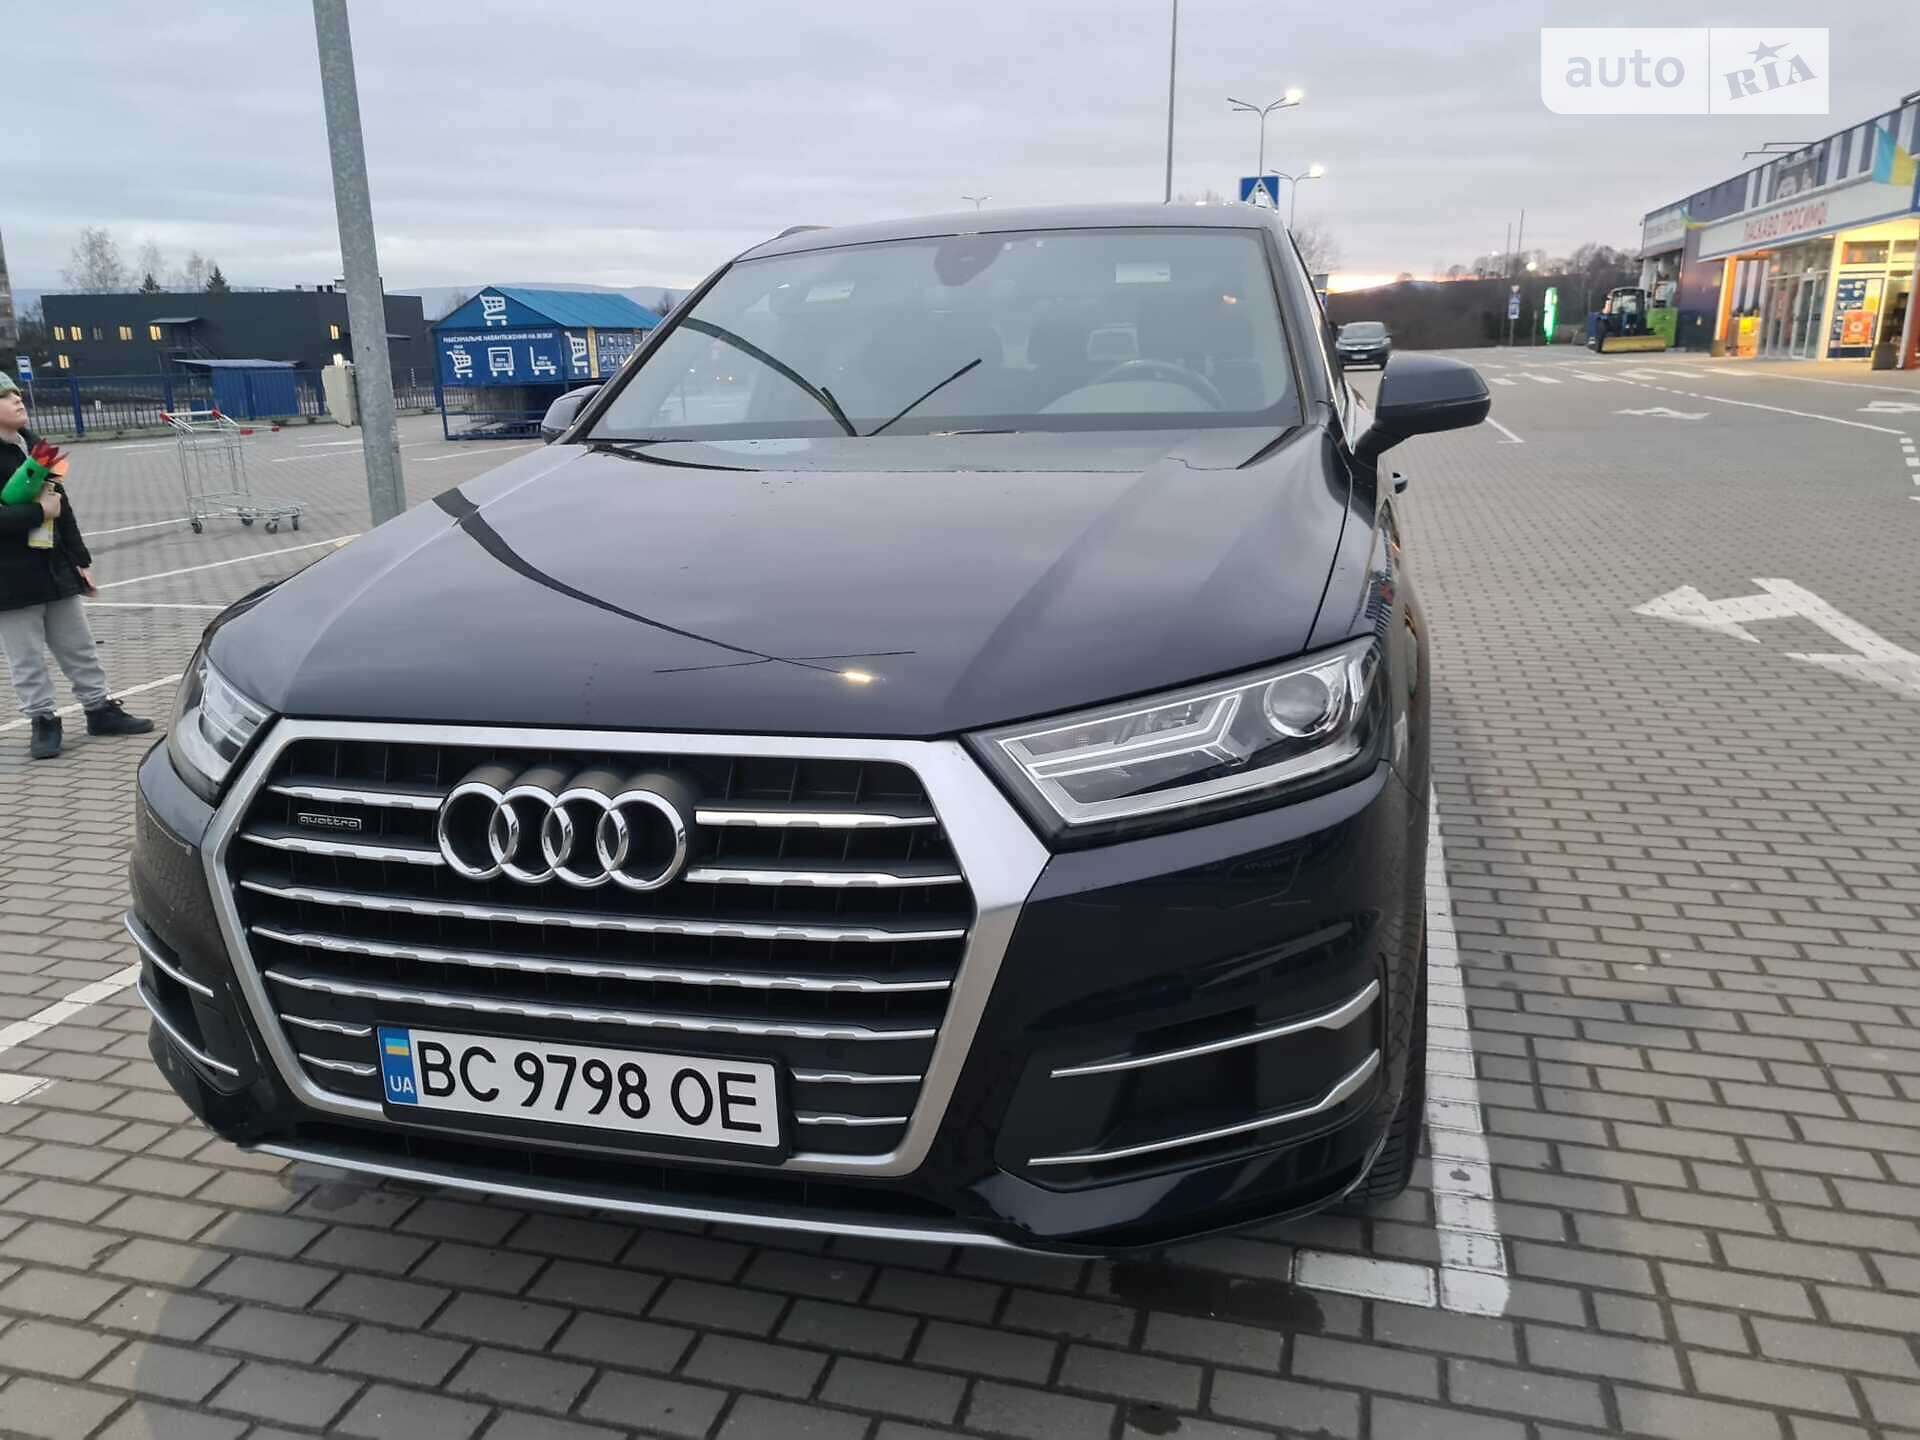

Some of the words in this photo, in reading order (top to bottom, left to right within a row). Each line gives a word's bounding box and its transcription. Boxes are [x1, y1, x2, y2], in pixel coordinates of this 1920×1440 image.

[300, 815, 357, 828] quattro
[390, 1075, 415, 1094] UA
[416, 1040, 500, 1103] BC
[513, 1052, 651, 1120] 9798
[670, 1067, 762, 1133] OE
